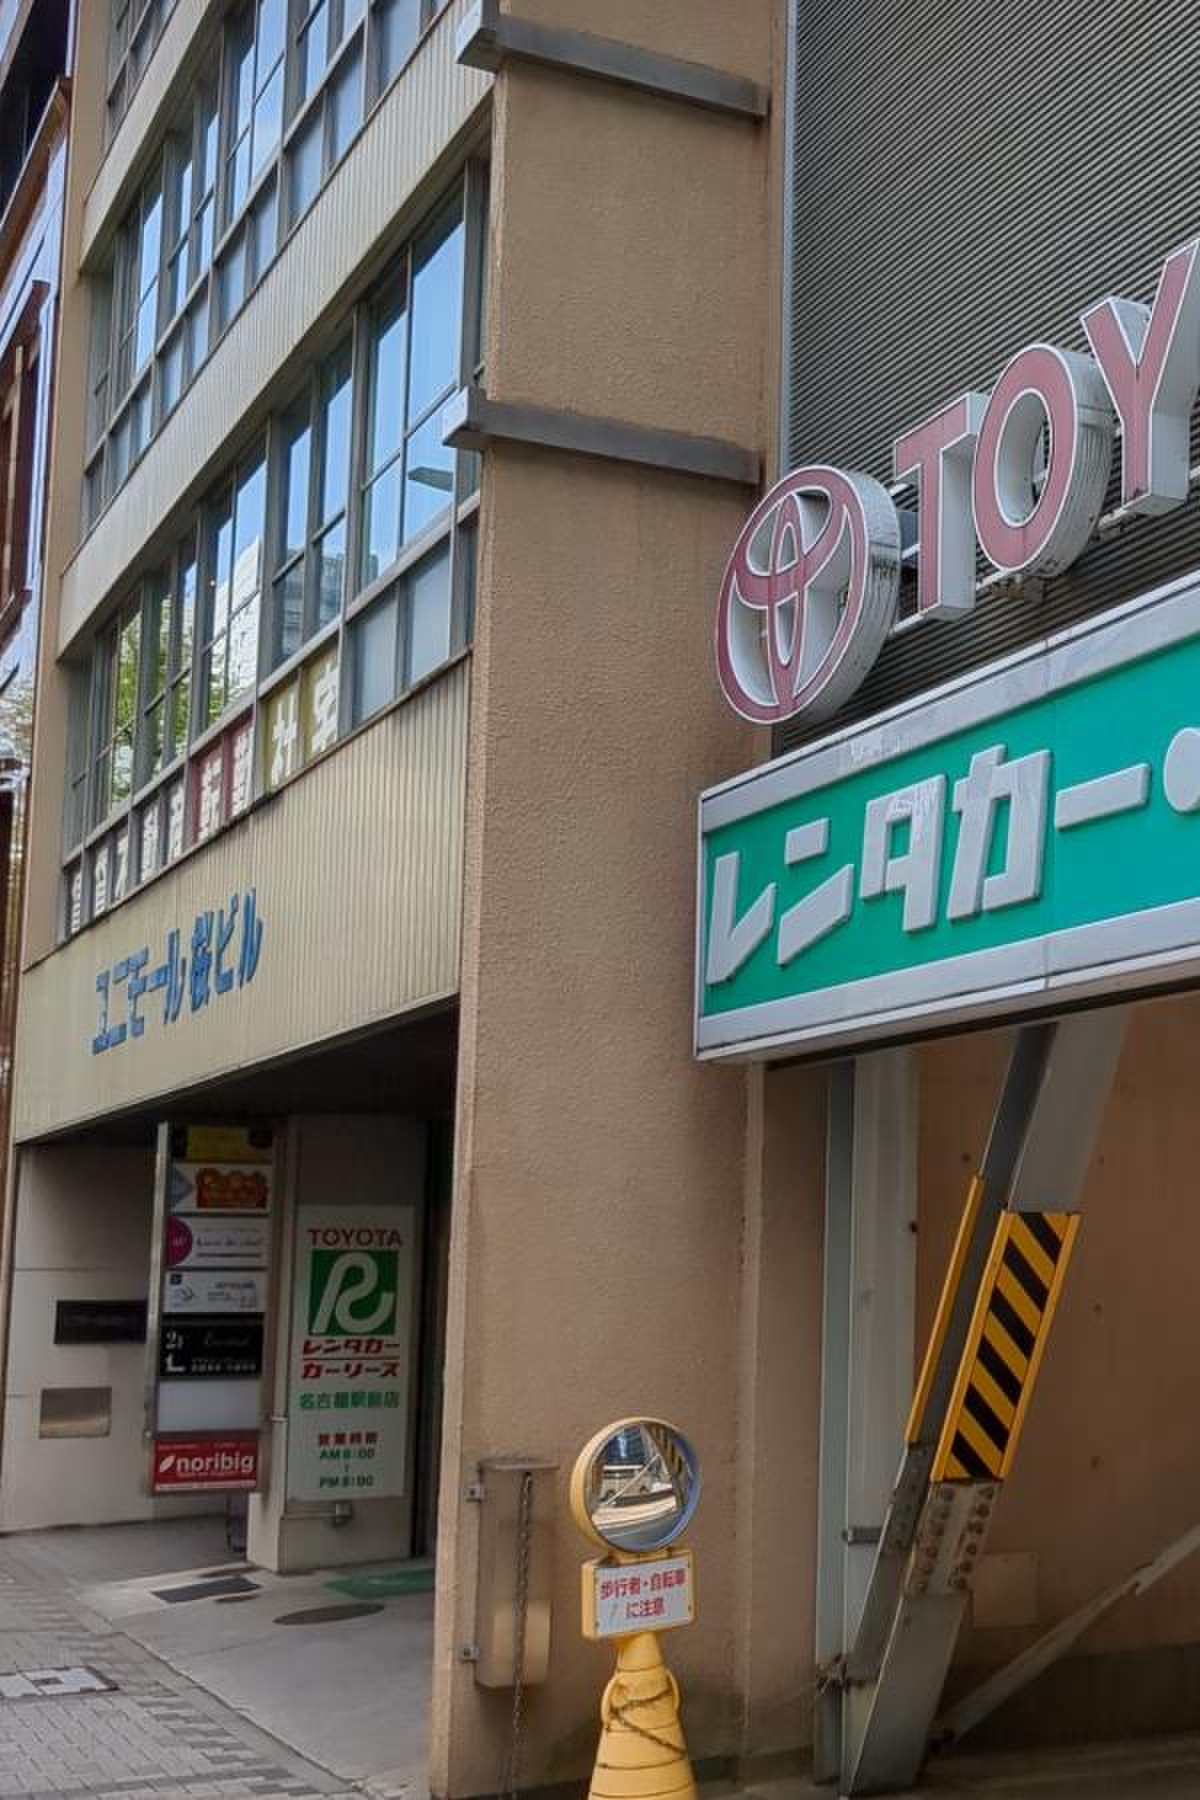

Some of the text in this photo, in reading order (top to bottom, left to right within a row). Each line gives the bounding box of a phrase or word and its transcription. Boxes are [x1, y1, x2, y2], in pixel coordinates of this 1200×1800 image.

[307, 1228, 403, 1246] TOYOTA
[303, 1338, 401, 1355] レンタカー
[302, 1362, 400, 1379] カーリース
[176, 1450, 254, 1473] noribig
[626, 1597, 666, 1619] に注意
